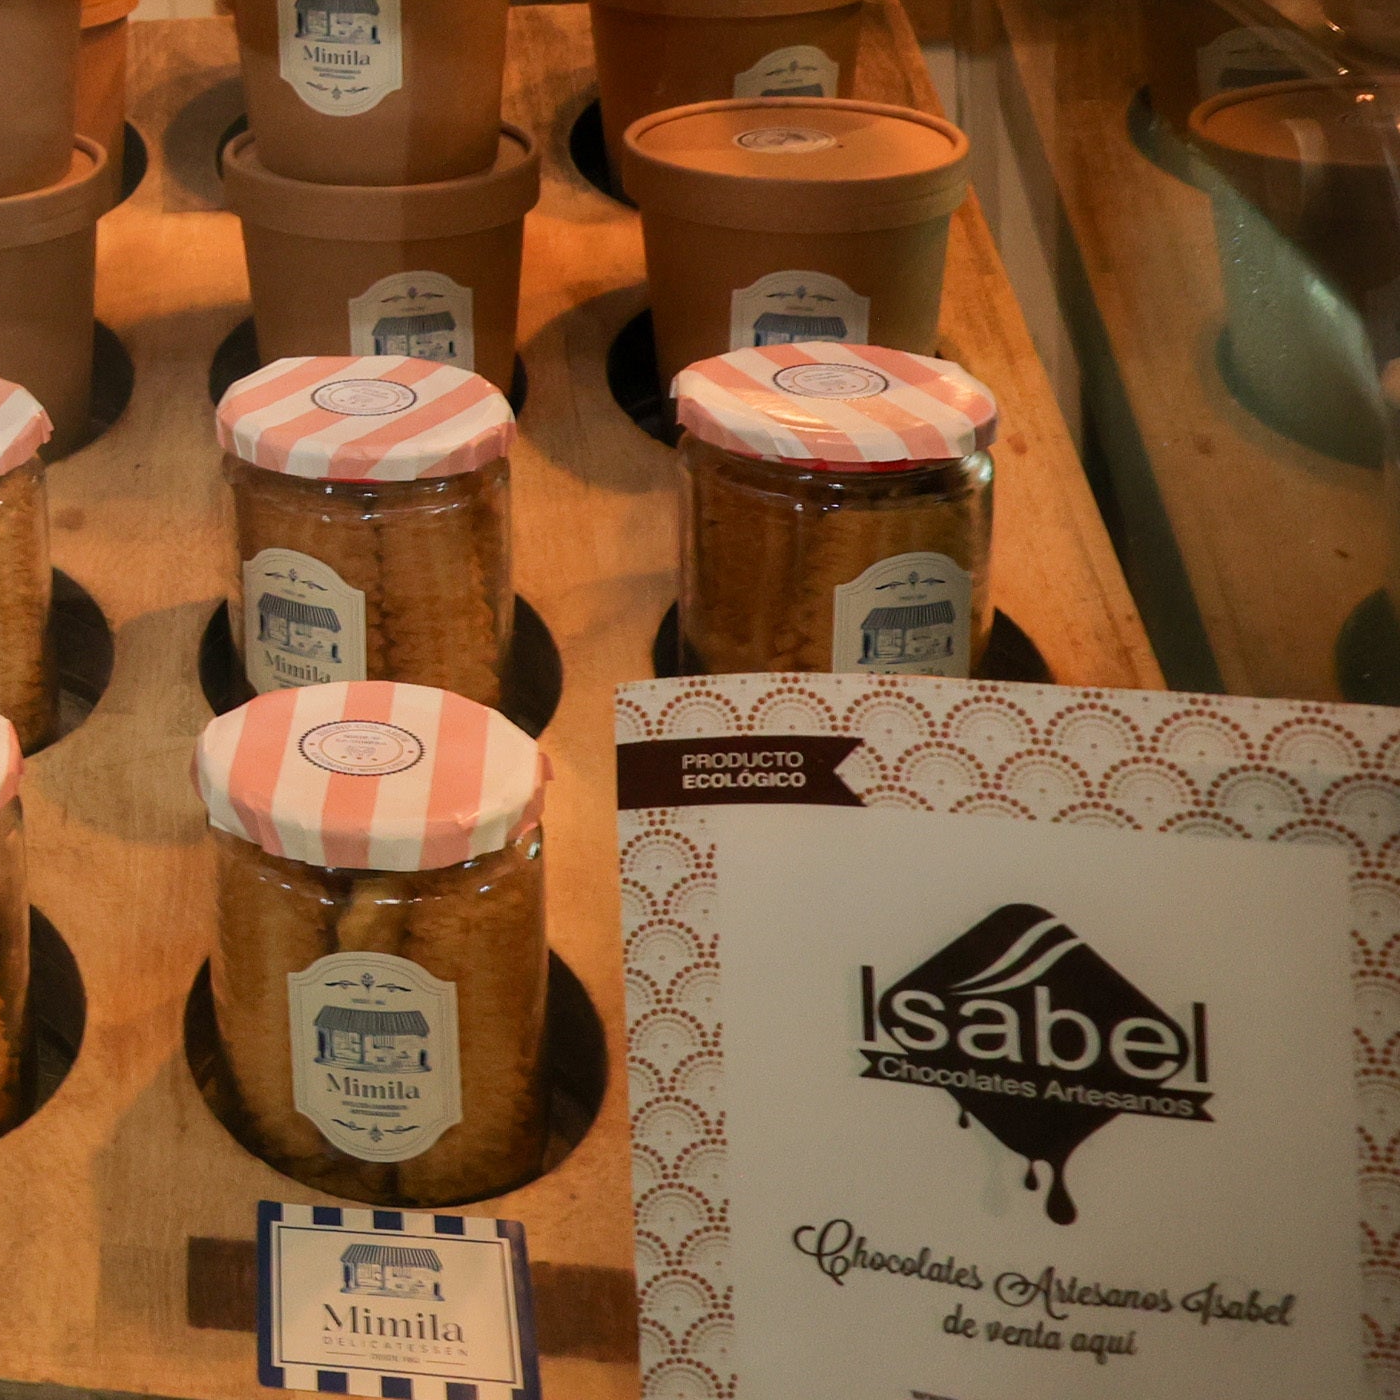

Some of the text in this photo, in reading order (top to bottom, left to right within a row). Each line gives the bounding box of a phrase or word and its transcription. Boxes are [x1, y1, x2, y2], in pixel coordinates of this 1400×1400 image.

[303, 43, 371, 68] Mimila
[263, 648, 331, 685] Mimila
[682, 750, 804, 770] PRODUCTO
[682, 769, 806, 789] ECOLÓGICO
[859, 965, 1209, 1086] Isabel
[326, 1071, 421, 1101] Mimila
[876, 1054, 1195, 1118] Chocolates Artesanos
[793, 1218, 1296, 1327] Chocolates Artesanos Isabel
[323, 1303, 465, 1343] Mimila
[943, 1303, 1137, 1365] de venta aquí
